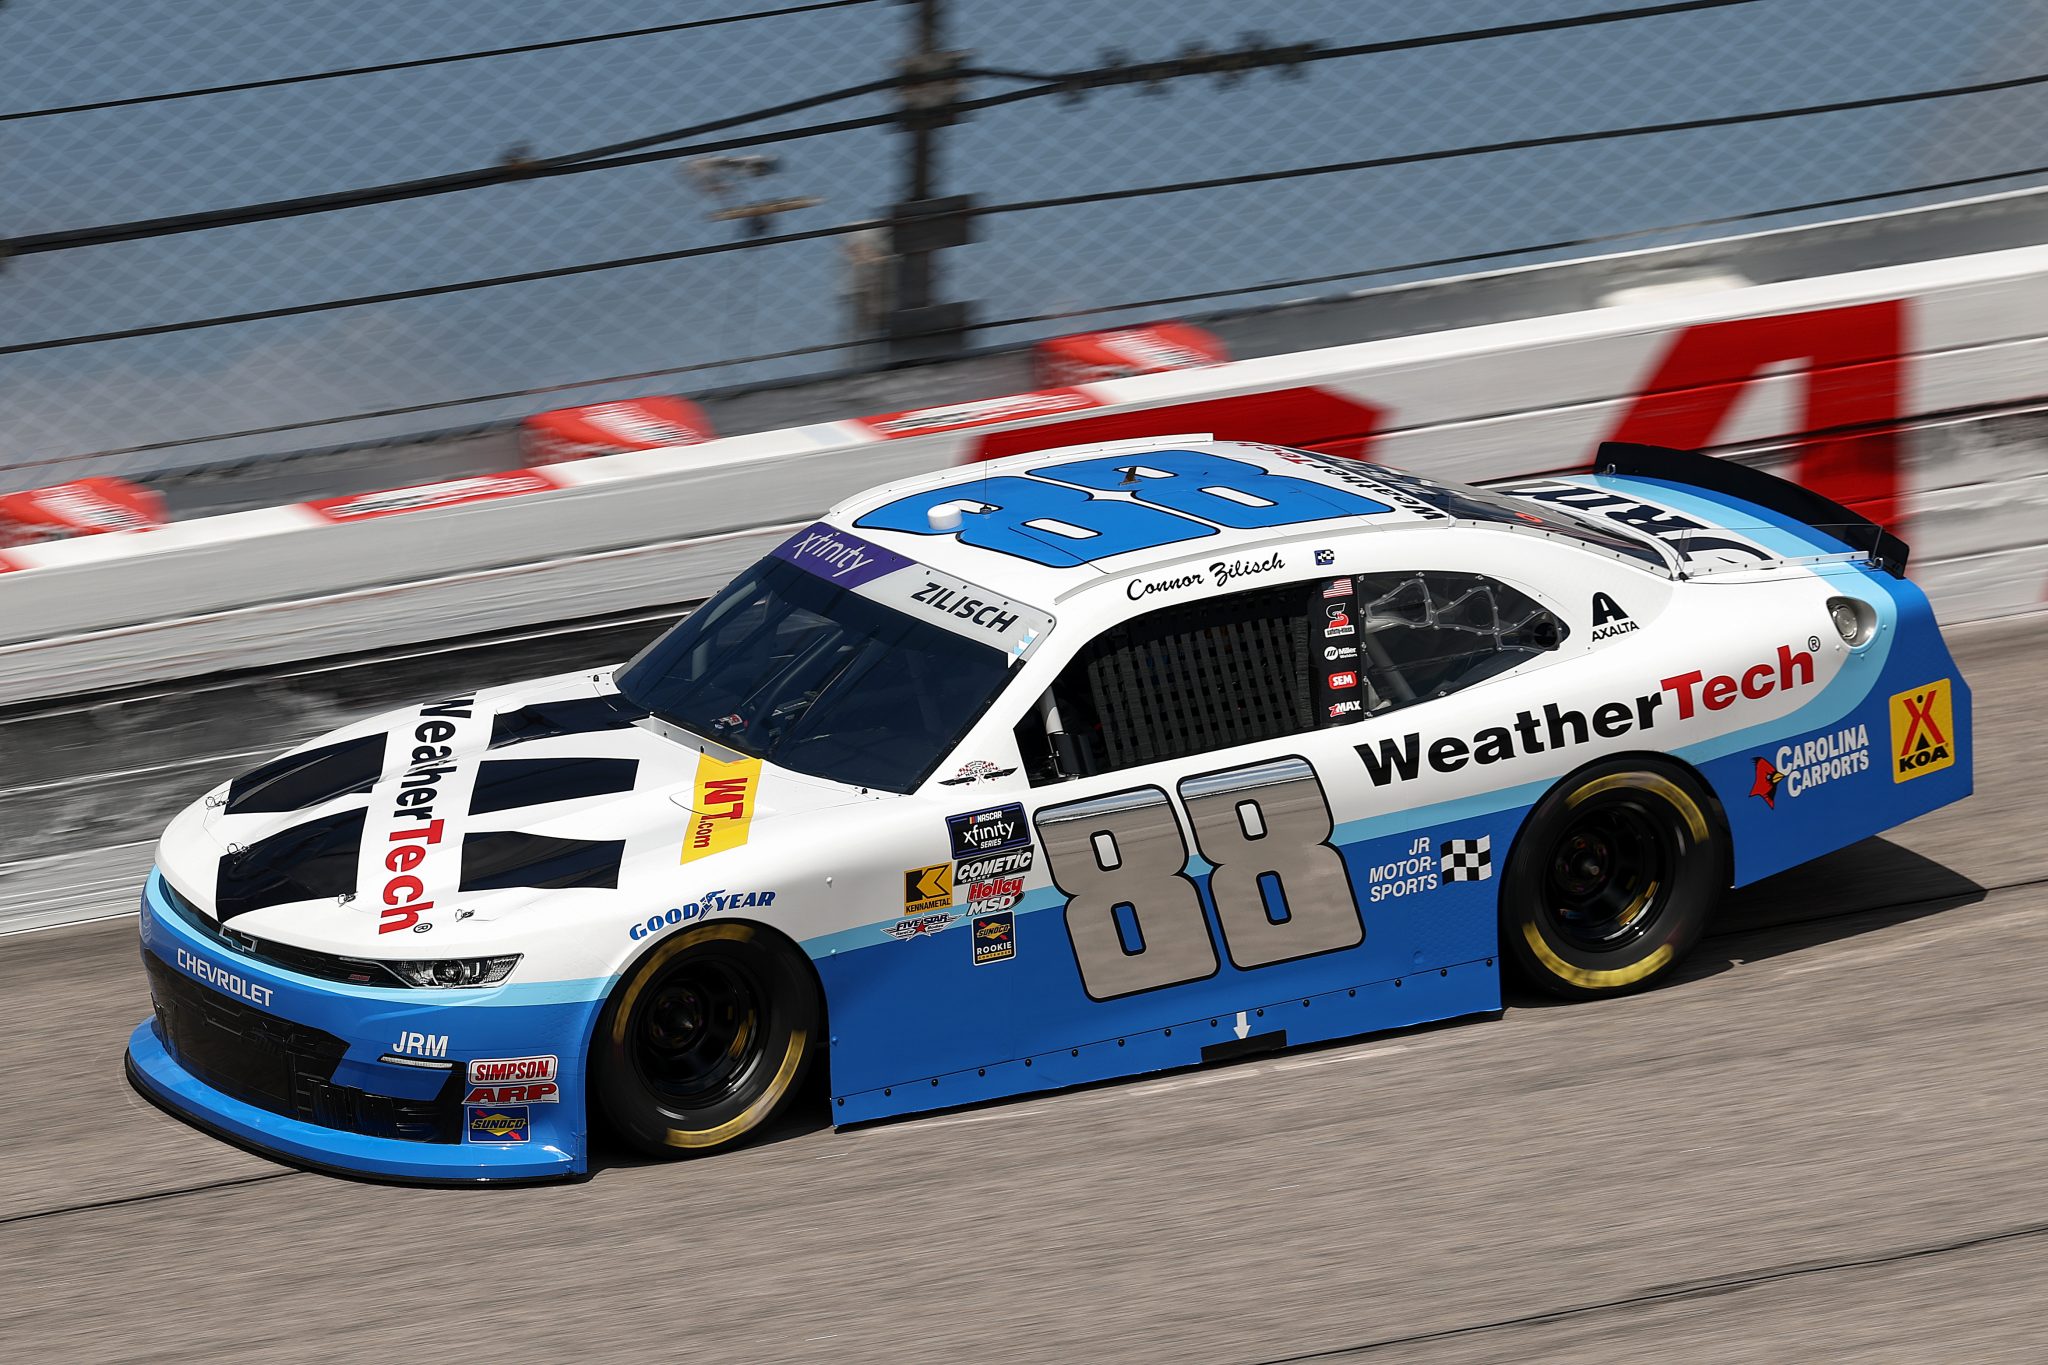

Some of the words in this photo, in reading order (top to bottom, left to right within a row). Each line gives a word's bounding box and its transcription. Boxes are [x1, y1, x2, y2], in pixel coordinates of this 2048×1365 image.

[793, 532, 874, 578] xfinity
[1127, 575, 1204, 601] Connor
[1209, 552, 1286, 587] Zilisch
[910, 582, 1019, 634] ZILISCH
[1591, 620, 1640, 642] AXALTA
[1332, 674, 1353, 687] SEM
[1776, 723, 1869, 776] CAROLINA
[1899, 745, 1949, 774] KOA
[1787, 750, 1869, 798] CARPORTS
[693, 777, 748, 849] WT.com
[977, 811, 1003, 823] NASCAR
[963, 821, 1015, 846] xfinity
[980, 838, 1002, 849] SERIES
[1409, 837, 1430, 856] JR
[957, 852, 1032, 880] COMETIC
[1033, 754, 1365, 1003] 88
[1369, 856, 1437, 884] MOTOR-
[968, 877, 1023, 901] Holley
[1370, 873, 1438, 902] SPORTS
[629, 890, 776, 941] GOODYEAR
[905, 898, 951, 913] KENNAMETAL
[967, 895, 1016, 916] MSD
[896, 919, 920, 931] FIVE
[977, 924, 1010, 938] SUNOCO
[976, 942, 1012, 955] ROOKIE
[177, 947, 274, 1007] CHEVROLET
[392, 1031, 449, 1057] JRM
[475, 1060, 550, 1081] SIMPSON
[464, 1083, 558, 1103] ARP
[473, 1118, 525, 1129] SUNOCO
